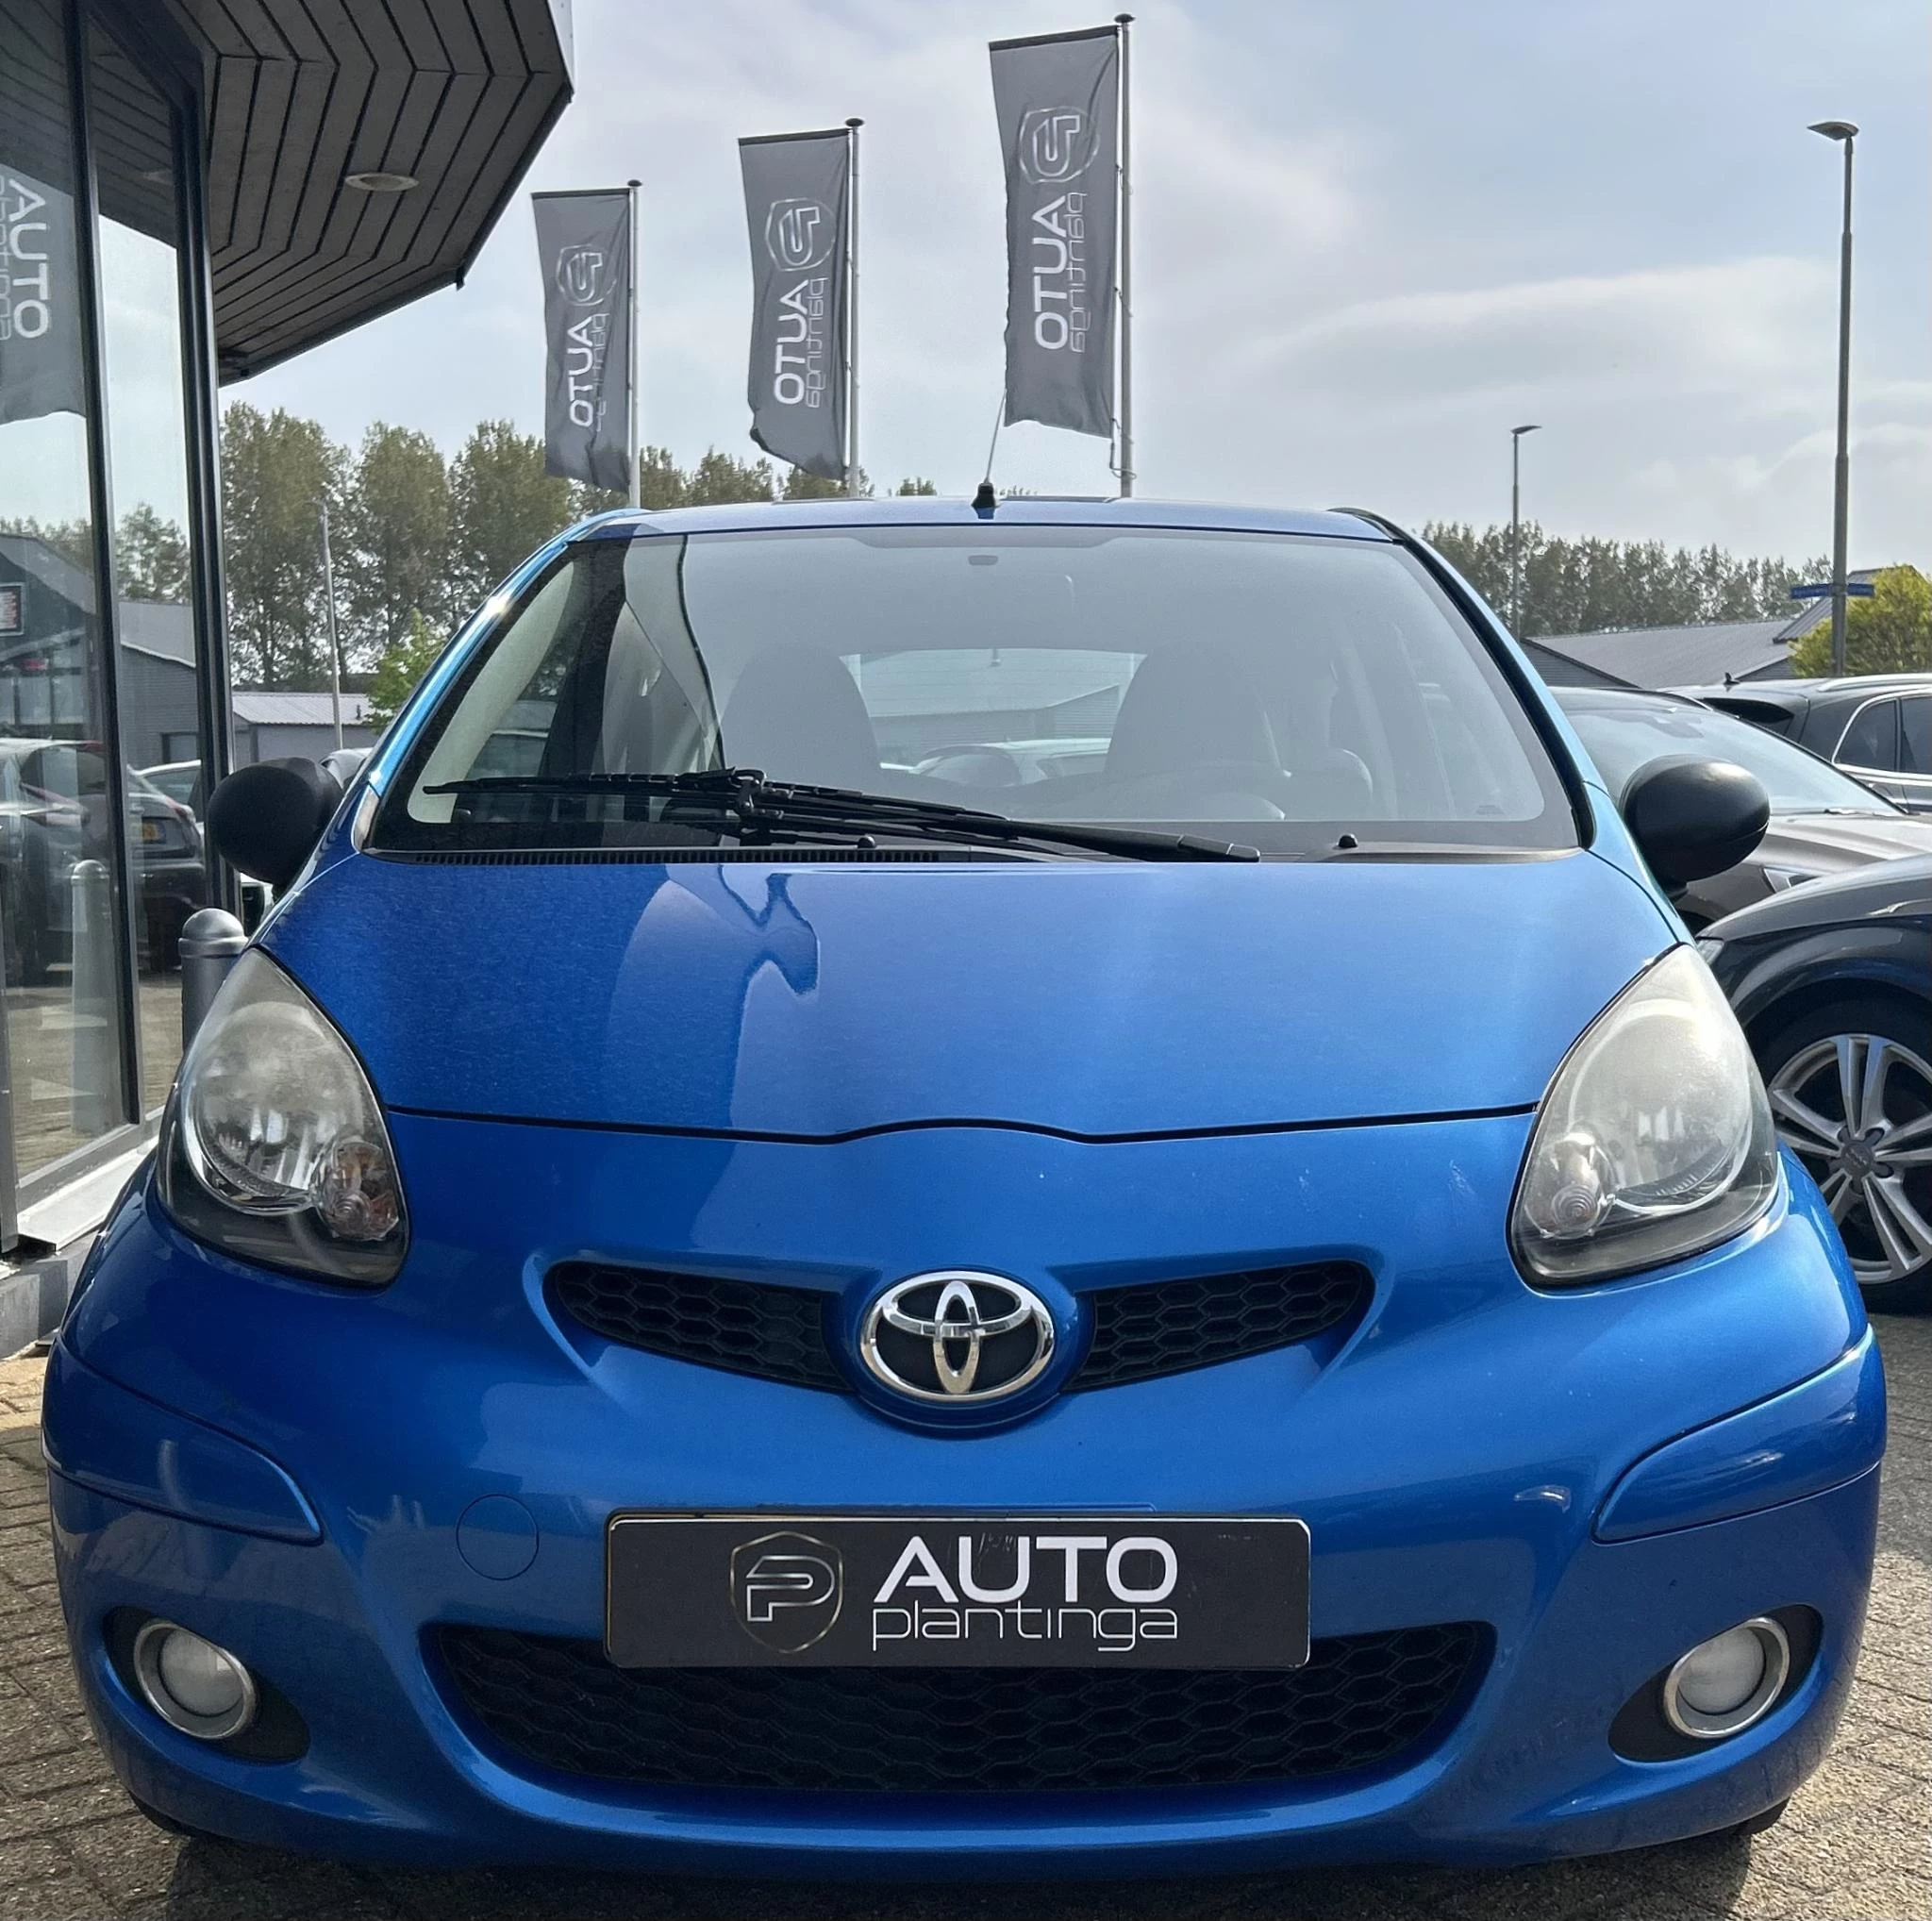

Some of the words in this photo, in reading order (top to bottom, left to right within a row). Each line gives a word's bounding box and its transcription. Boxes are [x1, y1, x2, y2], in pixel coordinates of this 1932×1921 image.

[8, 177, 50, 339] AUTO
[874, 1534, 1178, 1605] AUTO
[873, 1600, 1178, 1652] plantinga
